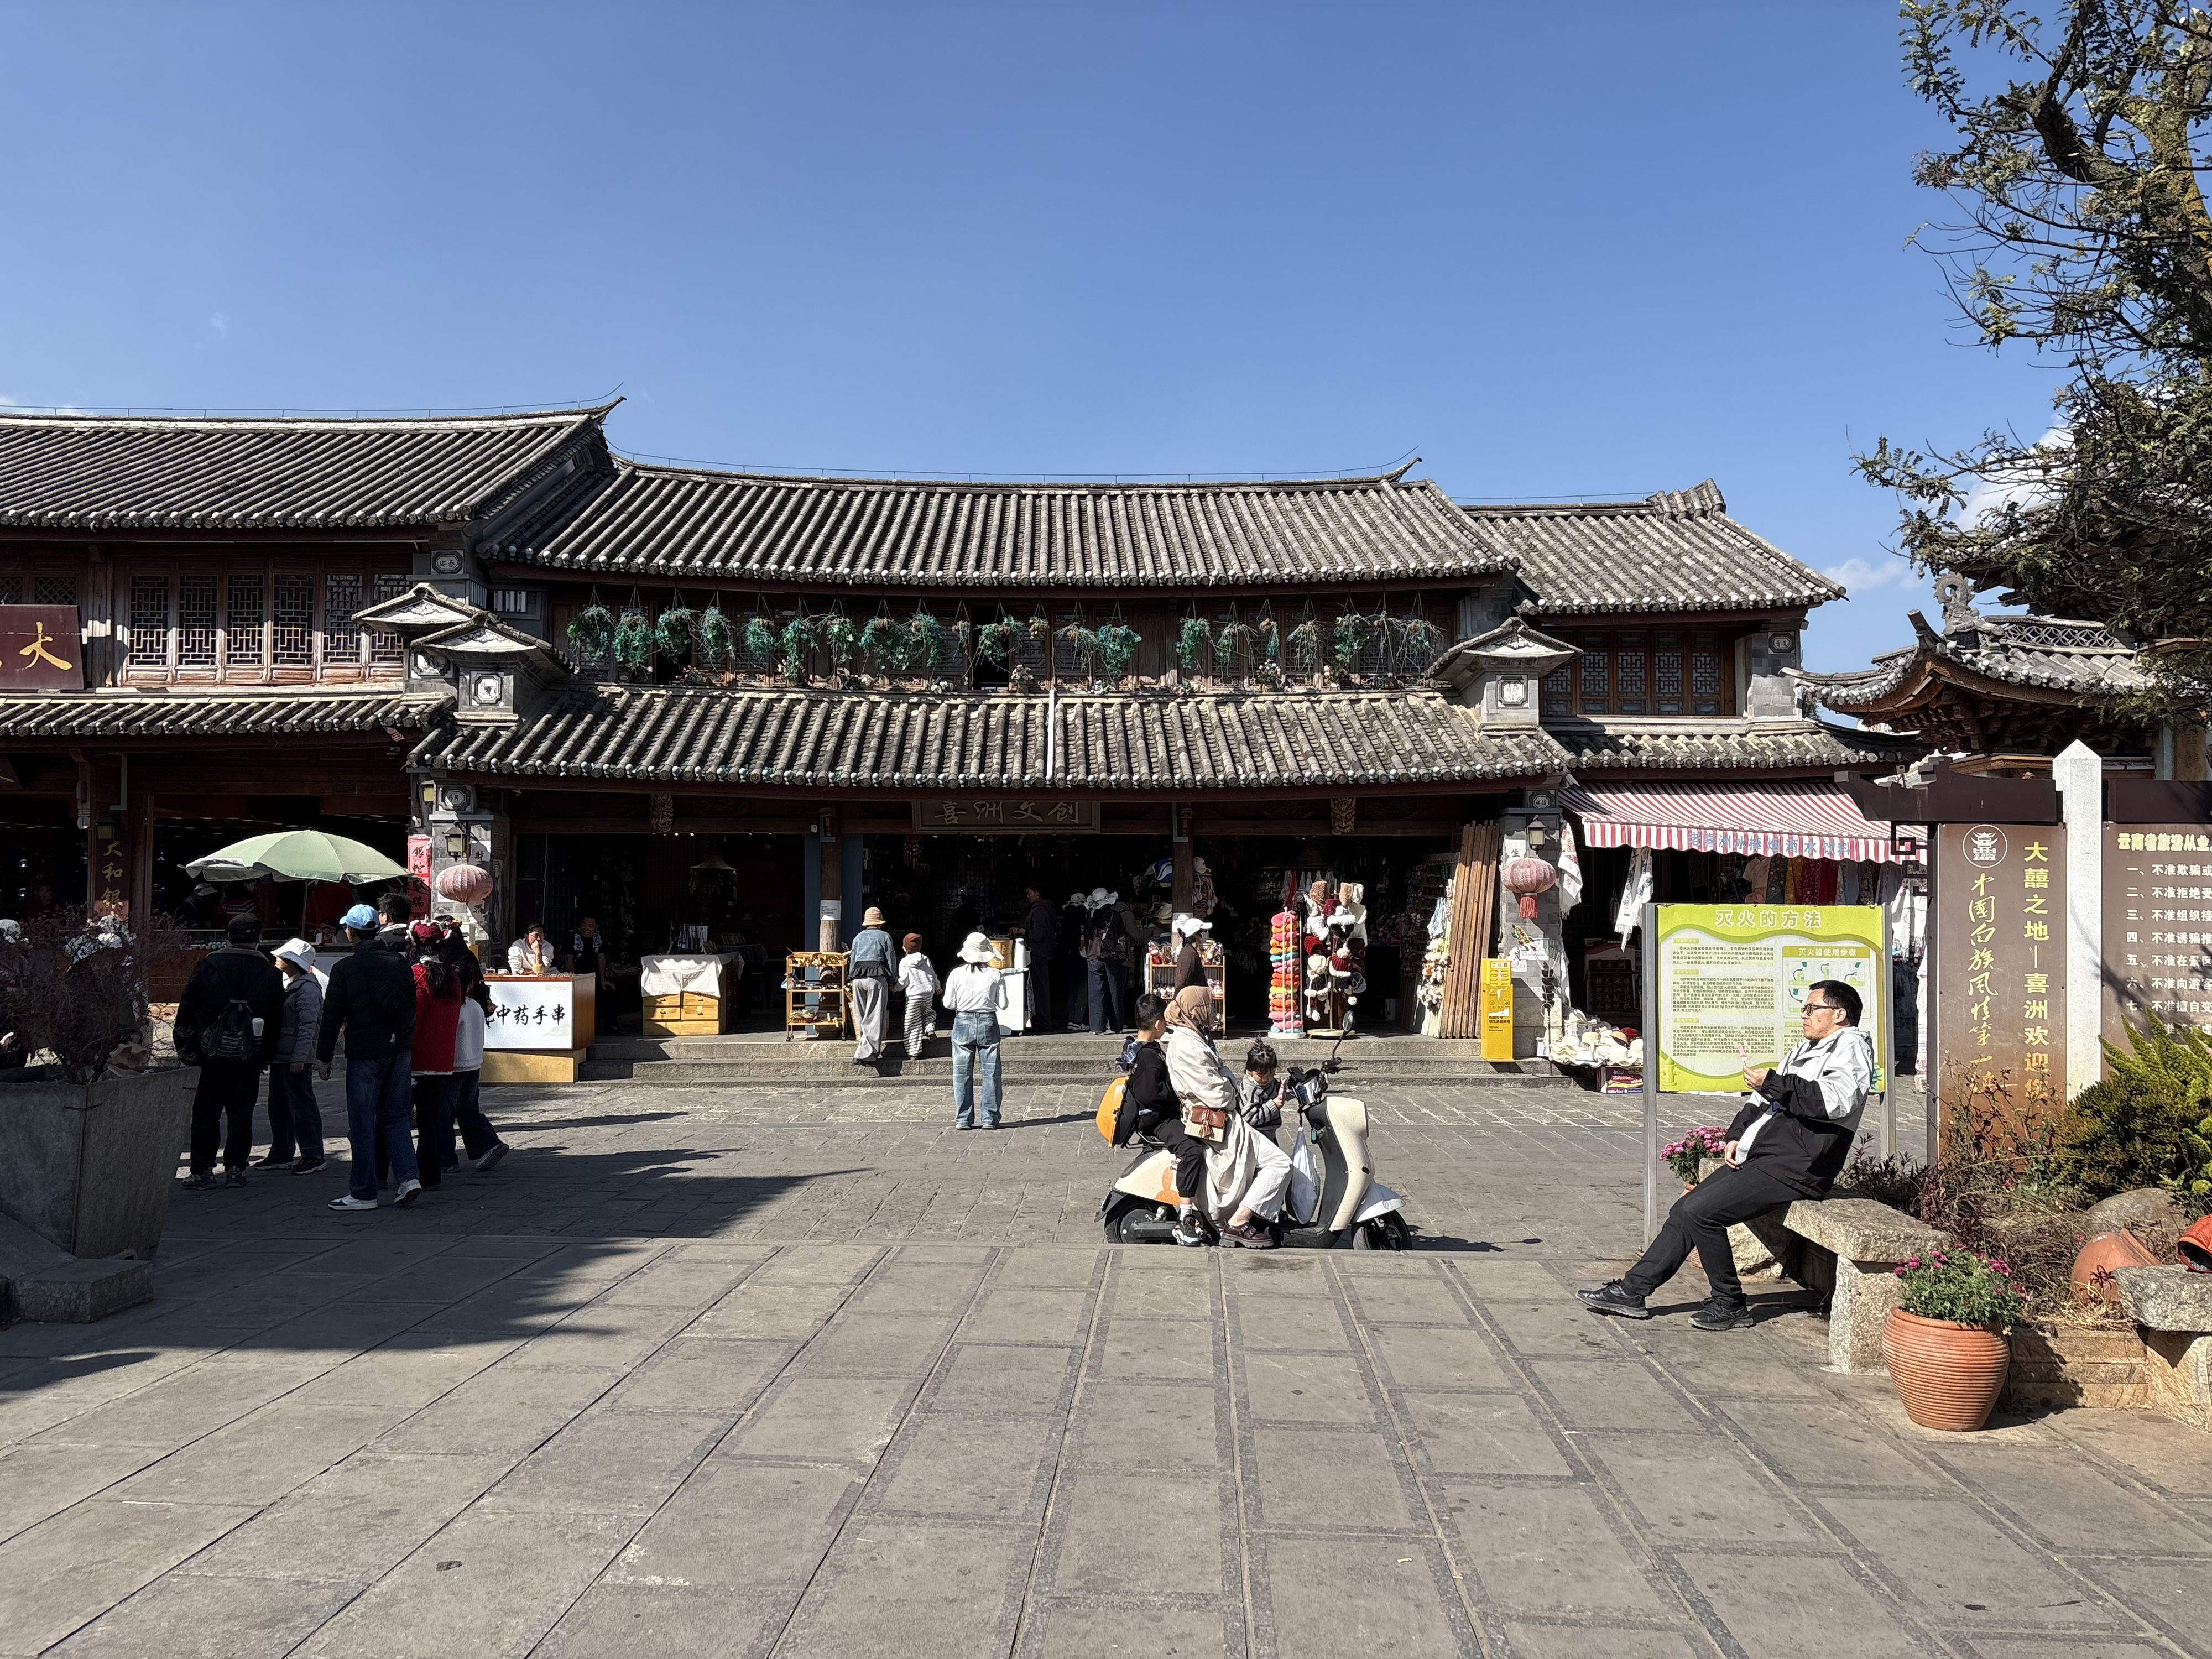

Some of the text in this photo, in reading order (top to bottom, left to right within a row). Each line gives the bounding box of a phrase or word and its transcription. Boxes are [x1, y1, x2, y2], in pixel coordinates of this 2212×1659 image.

[933, 800, 1079, 825] 喜洲文创
[2117, 833, 2212, 852] 云南省旅游从业
[2126, 864, 2212, 876] 一、不准欺骗或
[2126, 886, 2212, 899] 二、不准拒绝受
[1714, 909, 1822, 929] 灭火的方法
[2126, 909, 2212, 922] 三、不准组织接
[2126, 932, 2212, 945] 四、不准诱骗推
[1798, 948, 1856, 957] 灭火器使用步骤
[2126, 954, 2212, 967] 五、不准在景区
[2126, 977, 2212, 991] 六、不准向游客
[2126, 1000, 2212, 1013] 七、不准擅自变
[487, 1004, 565, 1026] 中药手串
